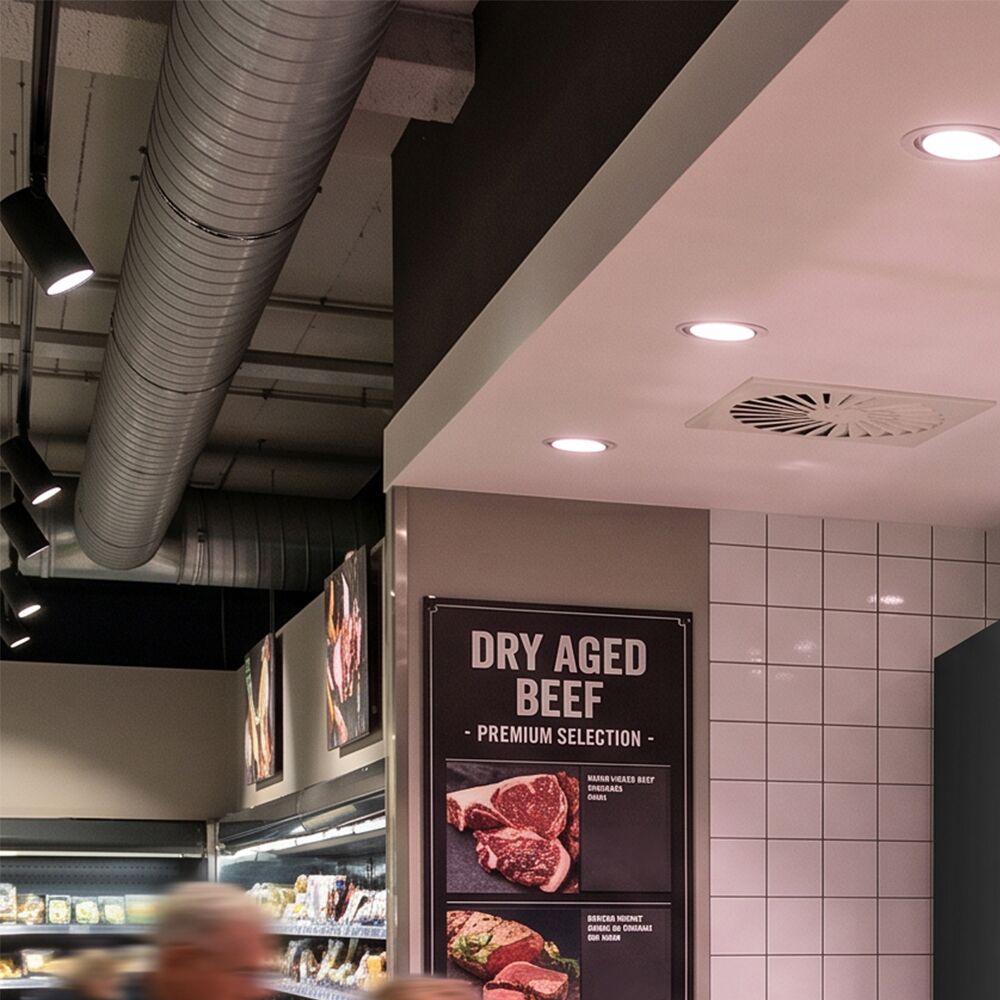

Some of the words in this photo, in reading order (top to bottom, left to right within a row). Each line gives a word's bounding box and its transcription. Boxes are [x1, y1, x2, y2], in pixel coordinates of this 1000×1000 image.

[472, 630, 543, 671] DRY
[553, 634, 647, 676] AGED
[516, 677, 604, 718] BEEF
[477, 724, 552, 744] PREMIUM
[557, 727, 641, 747] SELECTION
